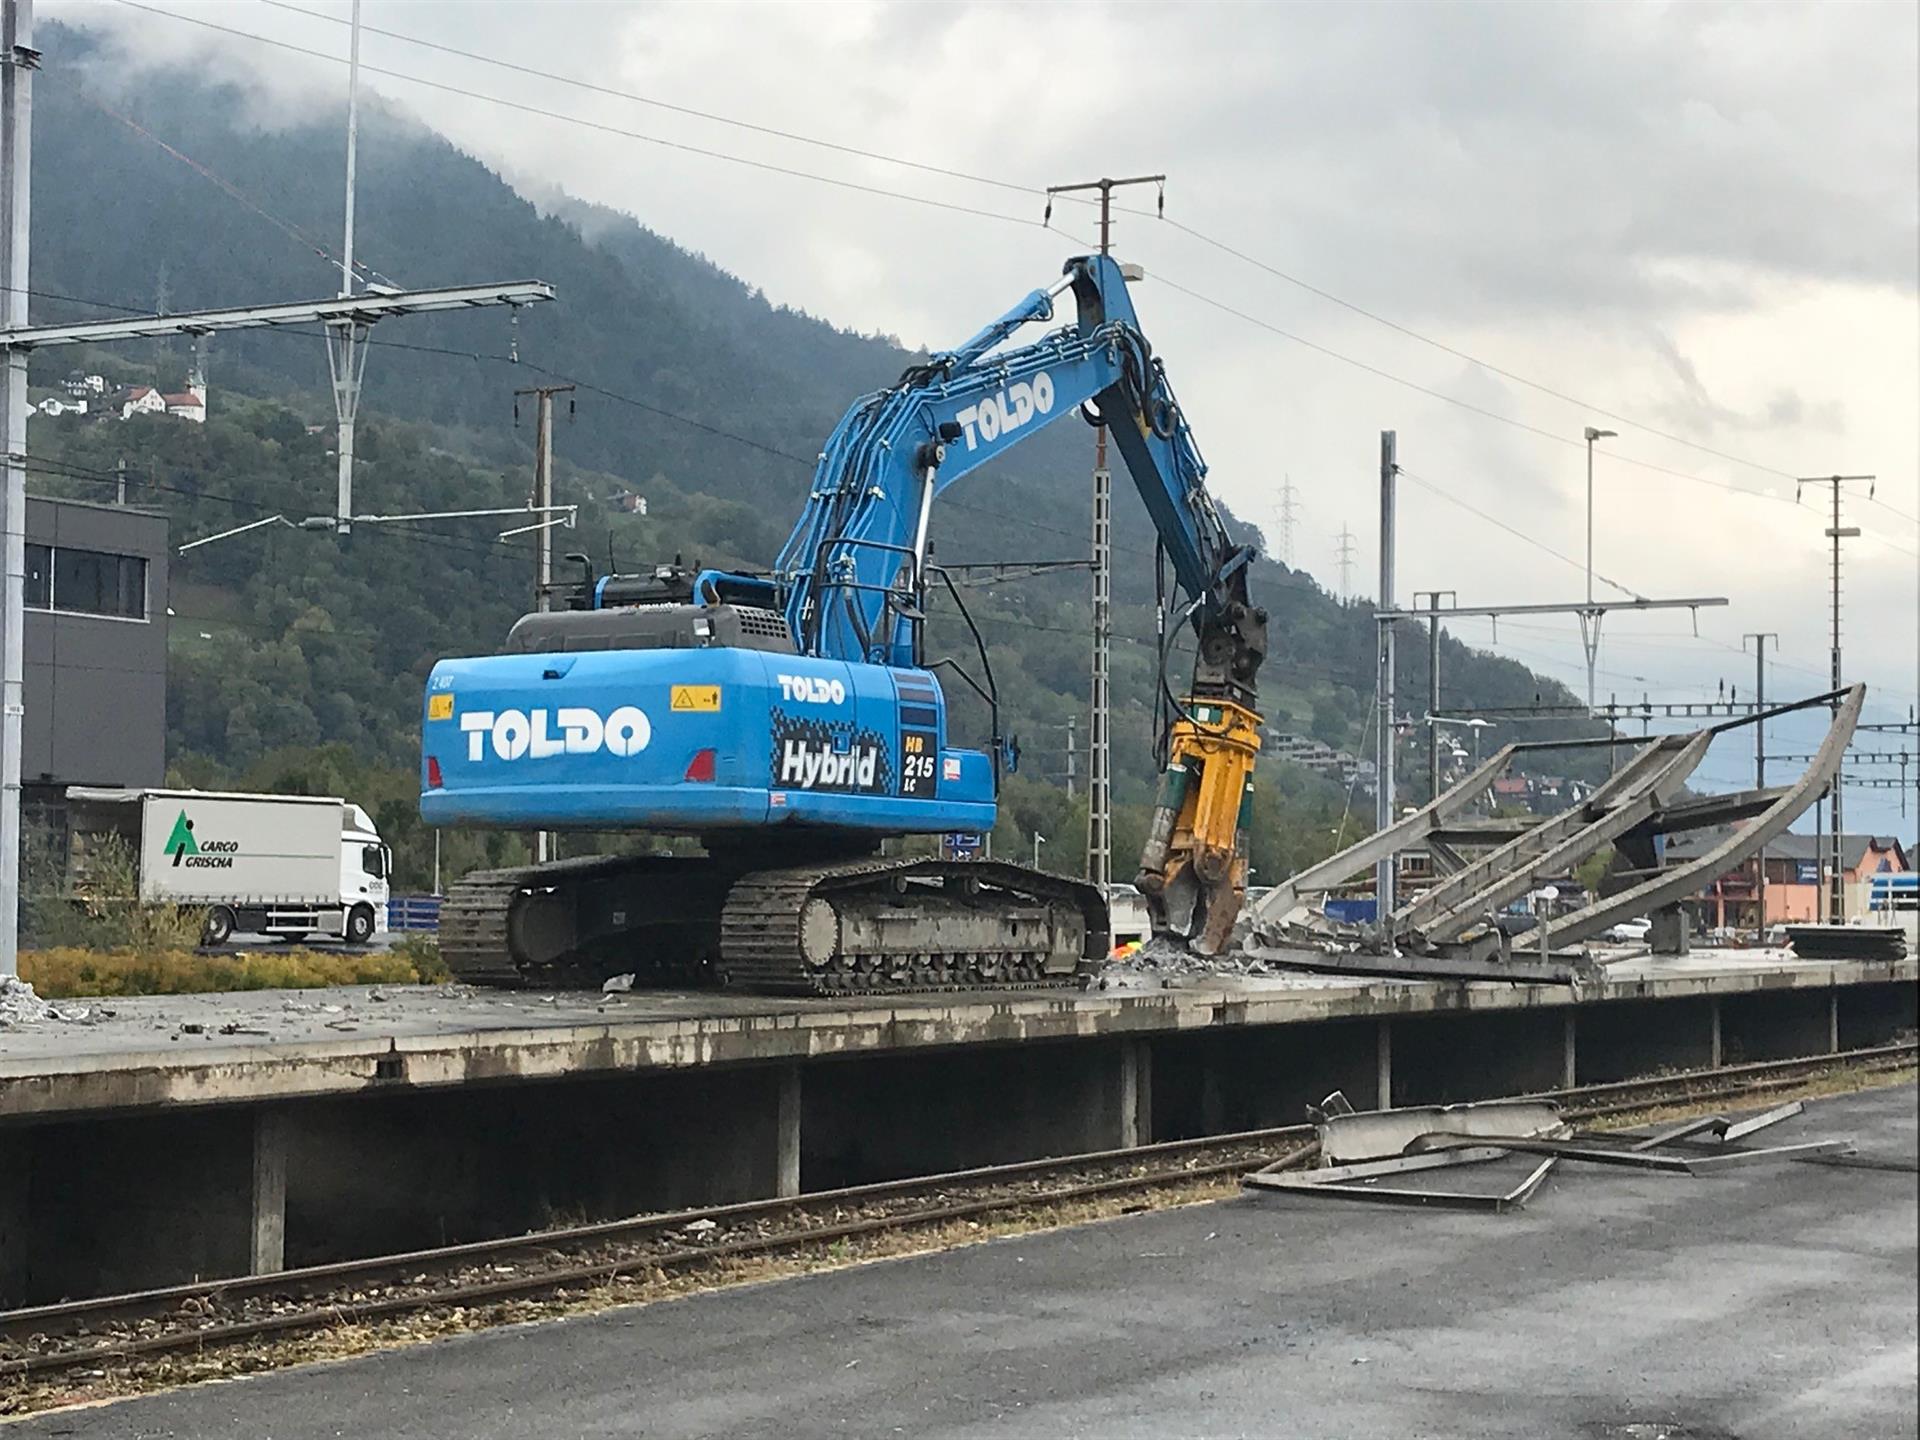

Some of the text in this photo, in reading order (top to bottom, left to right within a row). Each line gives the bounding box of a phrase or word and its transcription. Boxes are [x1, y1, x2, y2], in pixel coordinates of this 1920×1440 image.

[956, 372, 1054, 452] TOLDO
[778, 675, 846, 705] TOLDO
[460, 705, 651, 761] TOLDO
[905, 736, 924, 753] HB
[780, 740, 878, 788] Hybrid
[904, 755, 935, 778] 215
[903, 778, 917, 792] LC
[200, 841, 239, 853] CARGO
[185, 856, 233, 868] GRISCHA
